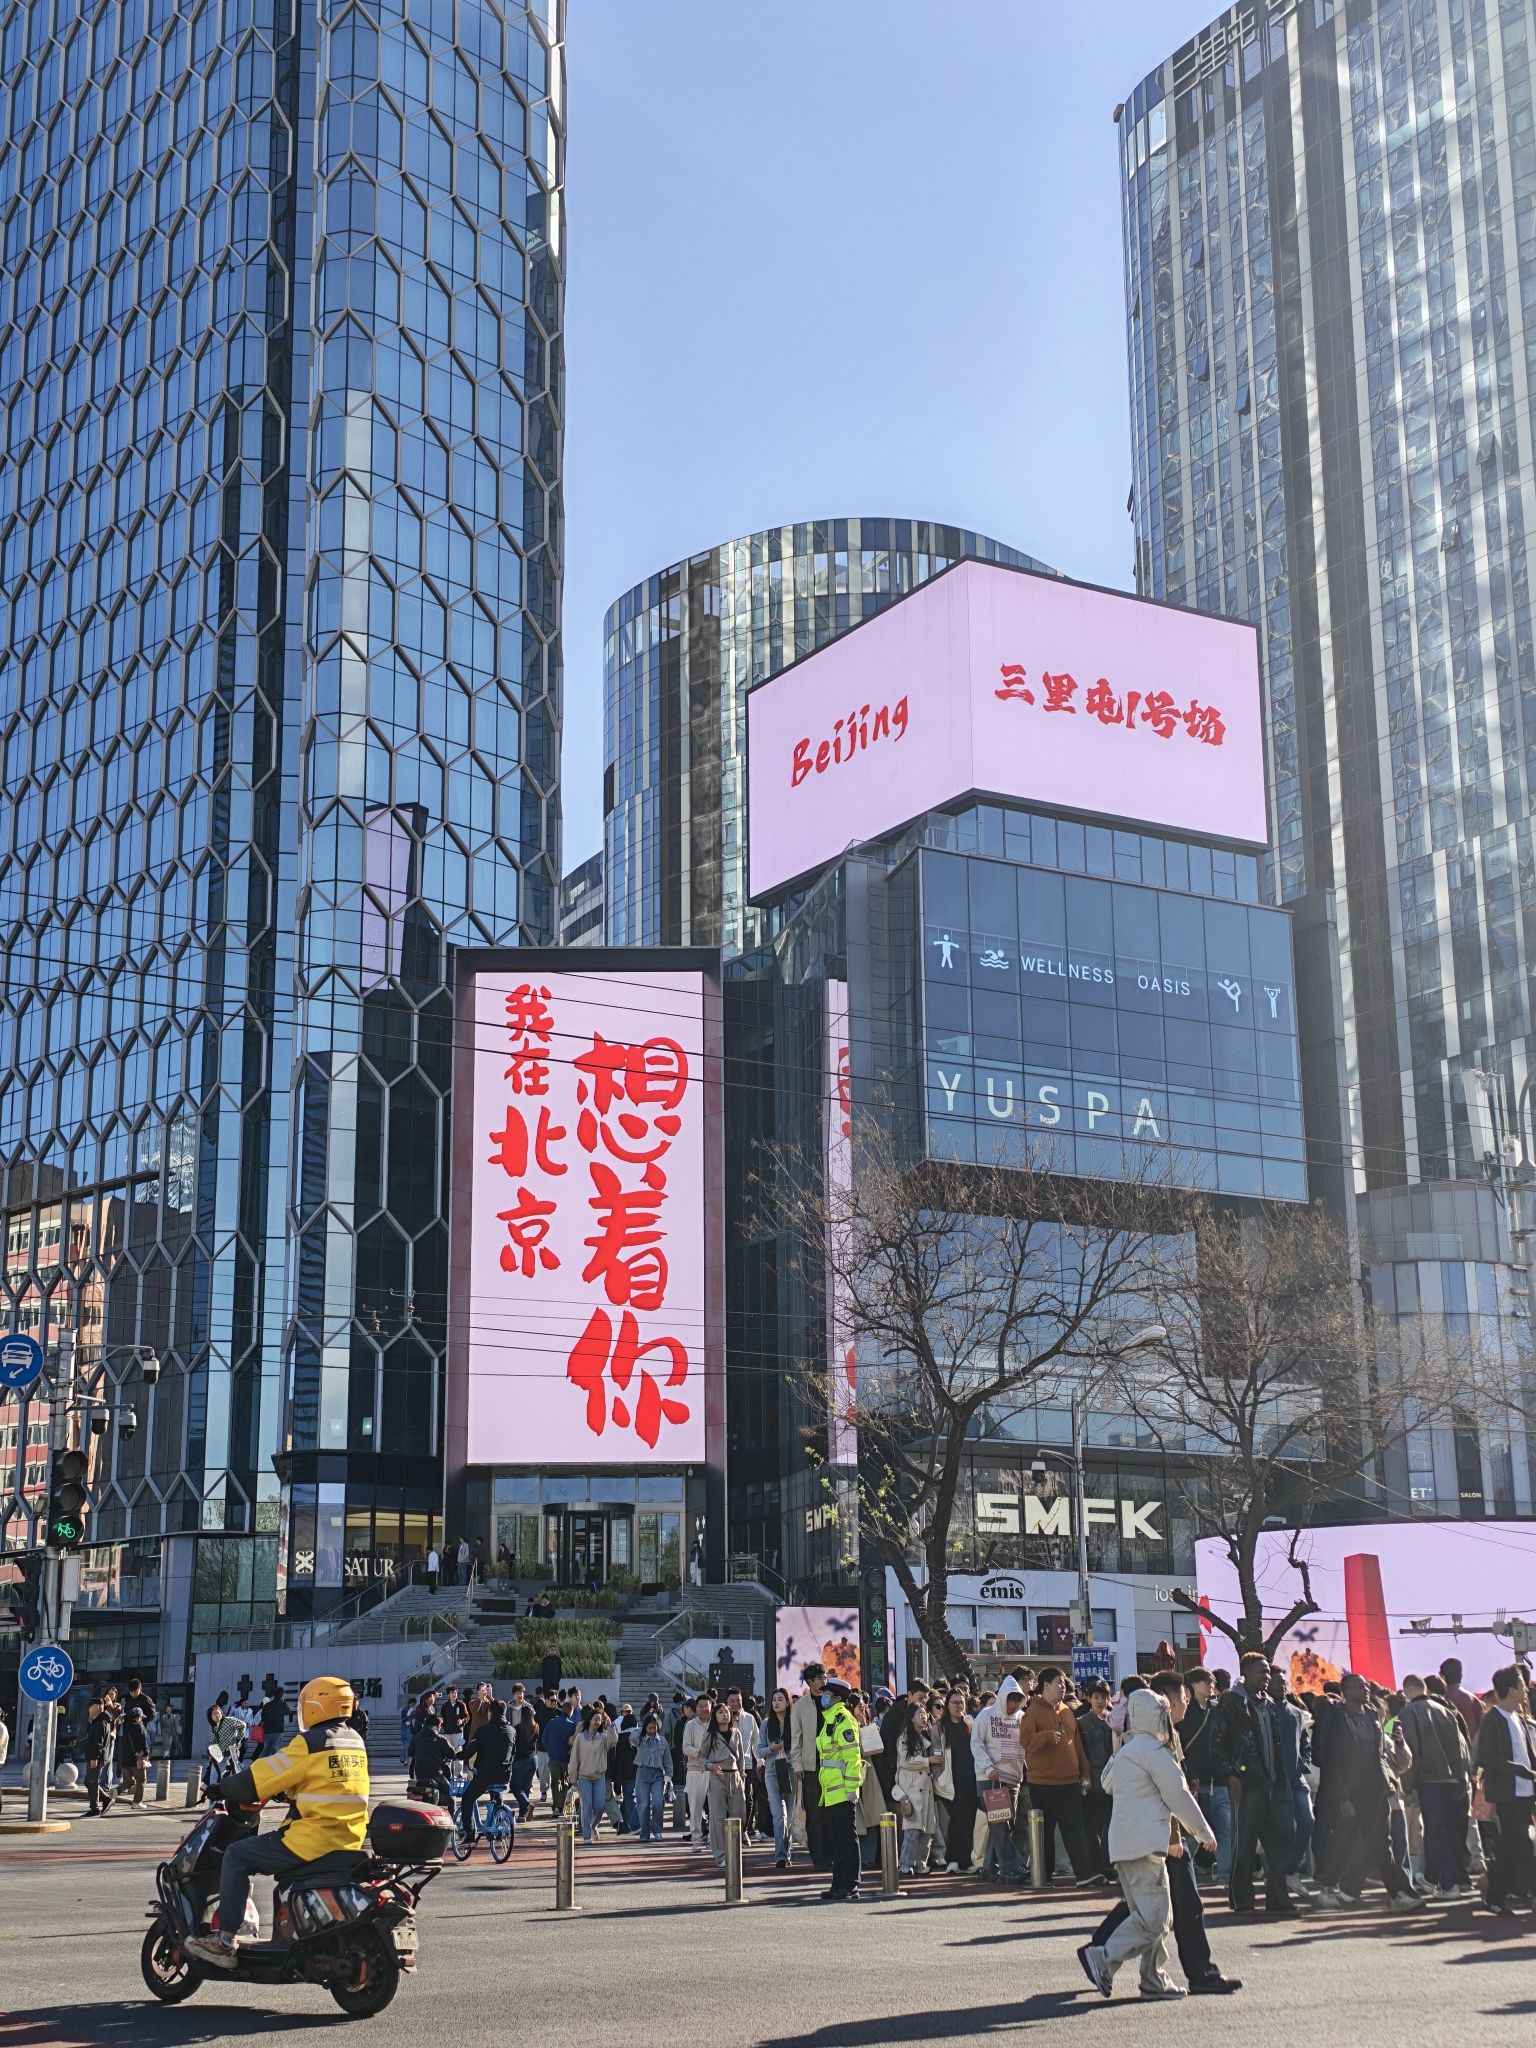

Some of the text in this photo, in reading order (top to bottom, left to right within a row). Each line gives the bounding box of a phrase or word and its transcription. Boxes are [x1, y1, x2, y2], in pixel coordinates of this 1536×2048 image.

[791, 695, 909, 788] Beijing
[1021, 956, 1190, 996] WELLNESS OASIS
[488, 982, 569, 1279] 我在北京
[937, 1070, 1161, 1138] YUSPA
[566, 1031, 691, 1450] 想着你
[977, 1493, 1163, 1540] SMFK
[345, 1557, 395, 1577] SATUR
[980, 1582, 1025, 1600] emis
